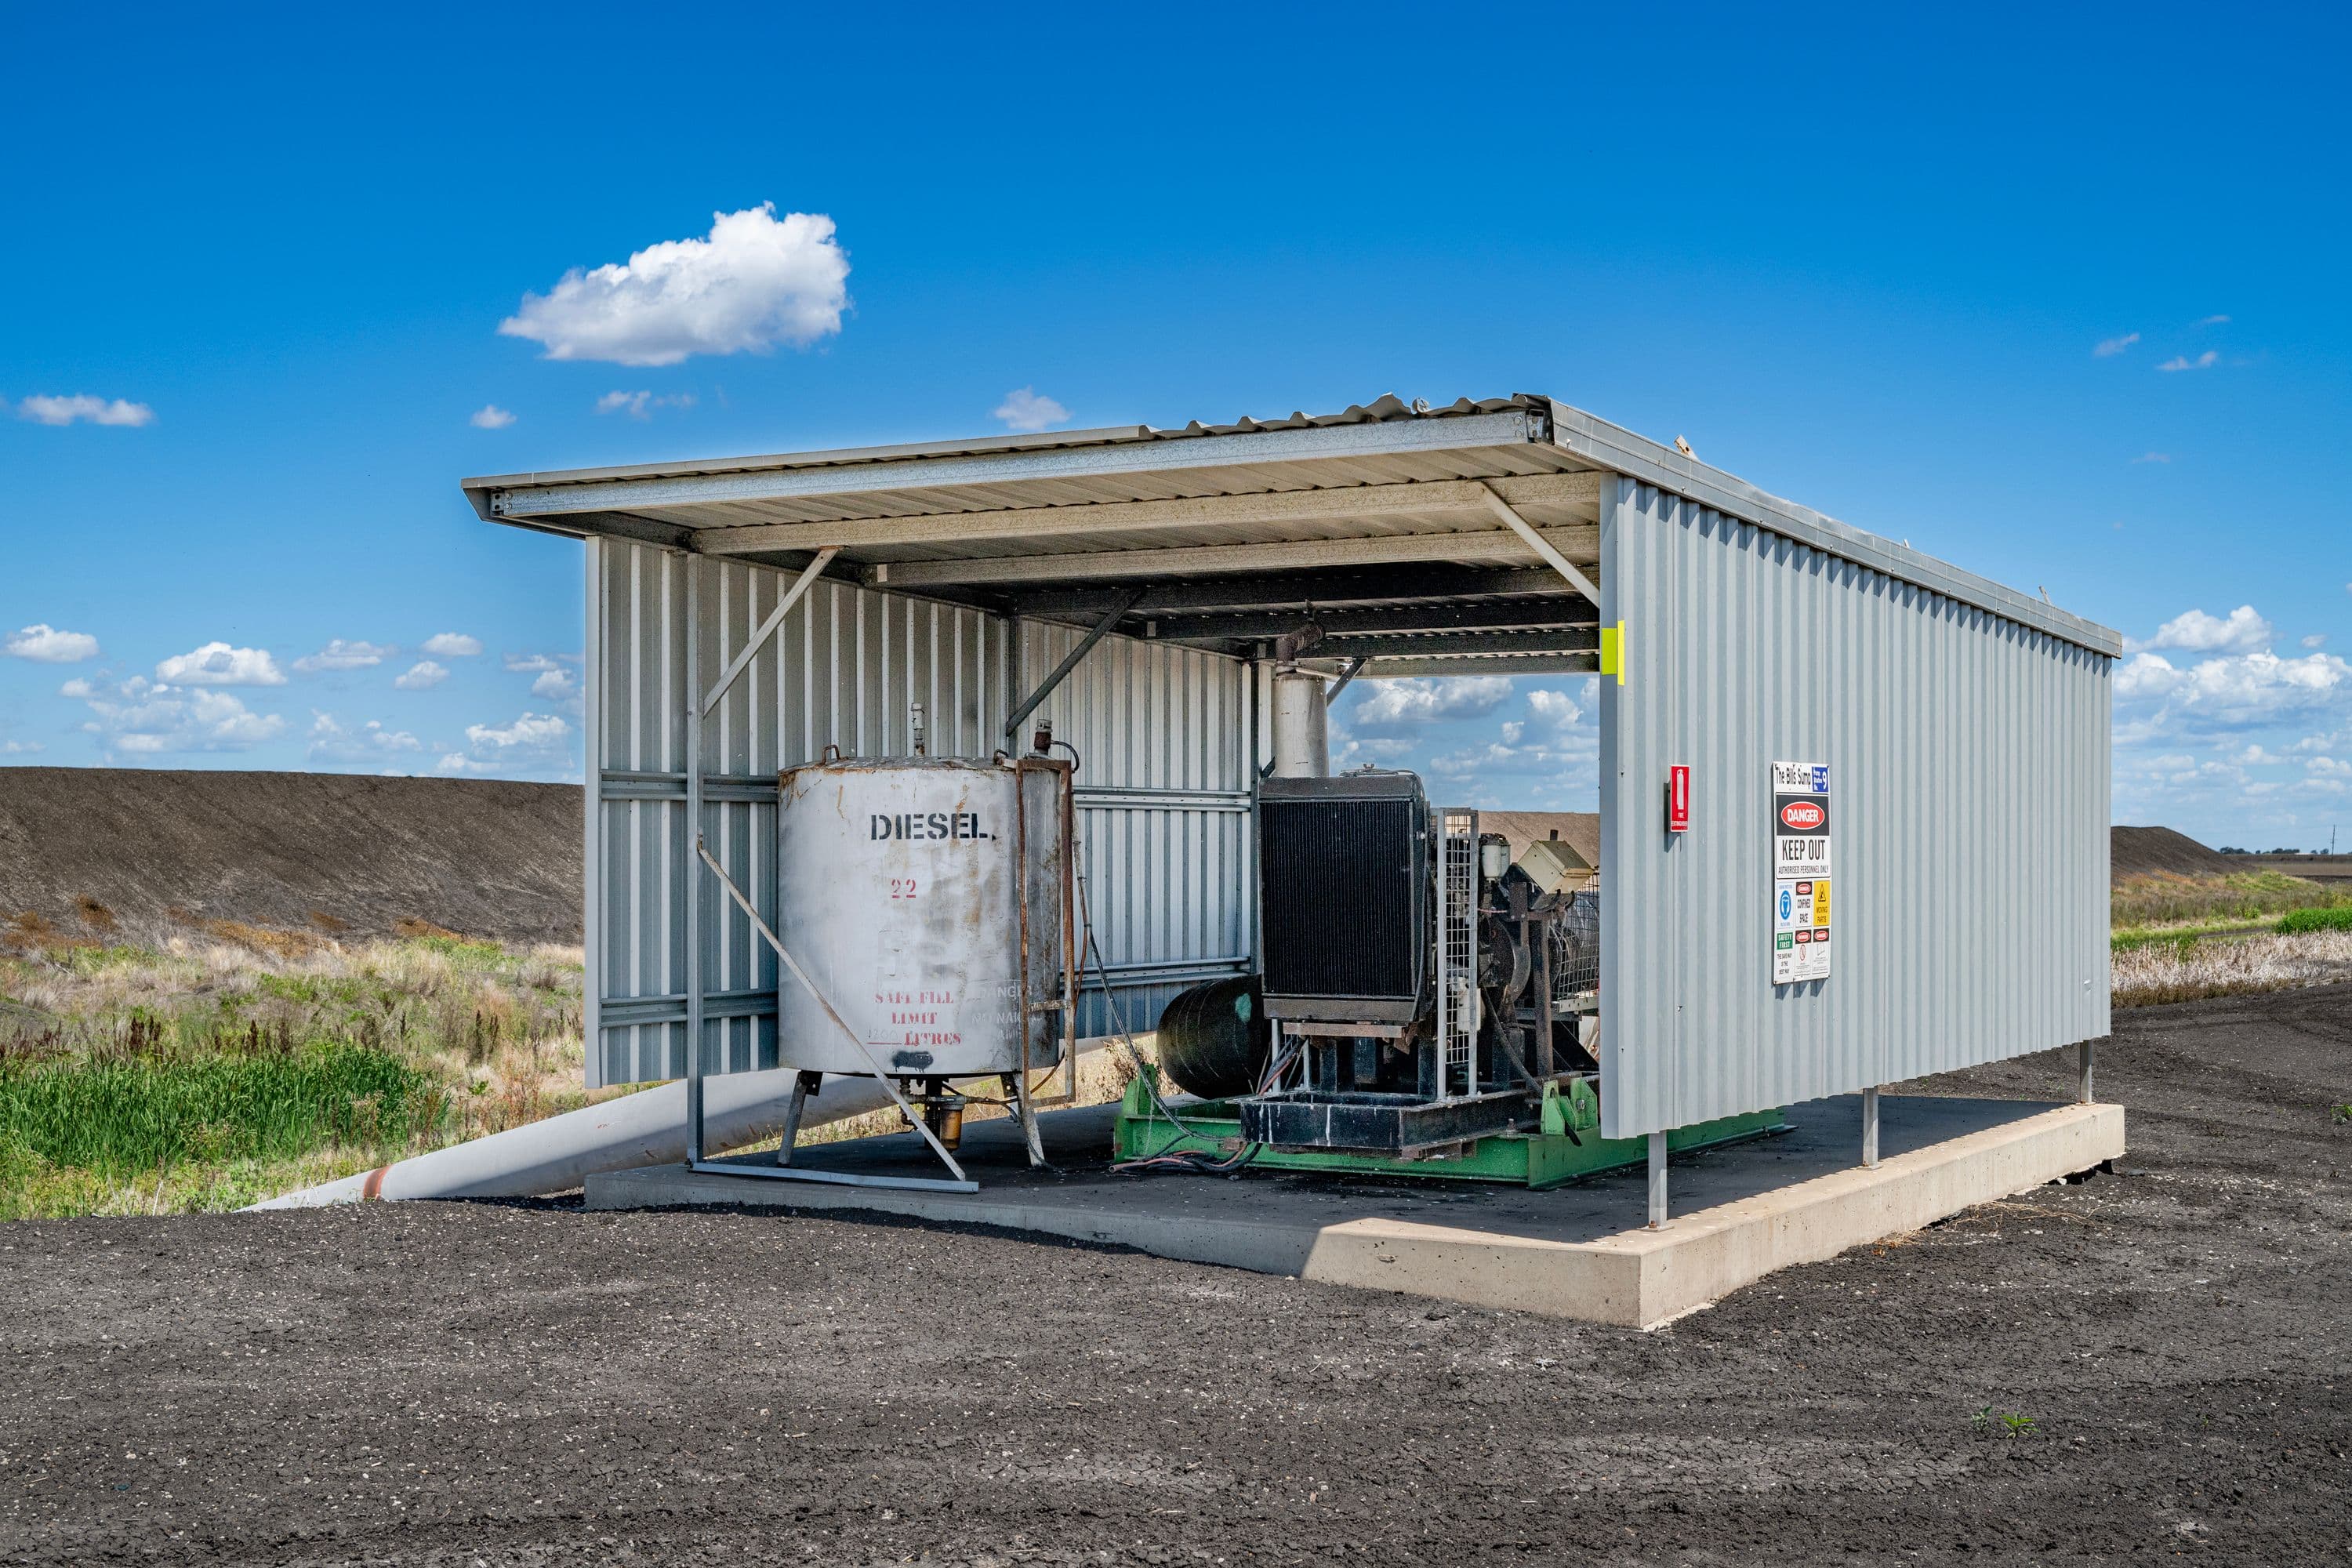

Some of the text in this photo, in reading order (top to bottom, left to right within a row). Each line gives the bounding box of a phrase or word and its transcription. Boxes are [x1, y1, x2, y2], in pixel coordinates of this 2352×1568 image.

[1776, 767, 1785, 785] The
[1798, 768, 1811, 789] Sump
[1822, 771, 1828, 789] 9
[1787, 808, 1819, 822] DANGER
[871, 812, 989, 840] DIESEL
[1782, 839, 1826, 861] KEEP OUT
[1778, 865, 1828, 874] AUTHORISED PERSONNEL ONLY
[919, 991, 954, 1004] FILL
[891, 1012, 938, 1025] LIMIT
[904, 1032, 963, 1046] LITRES
